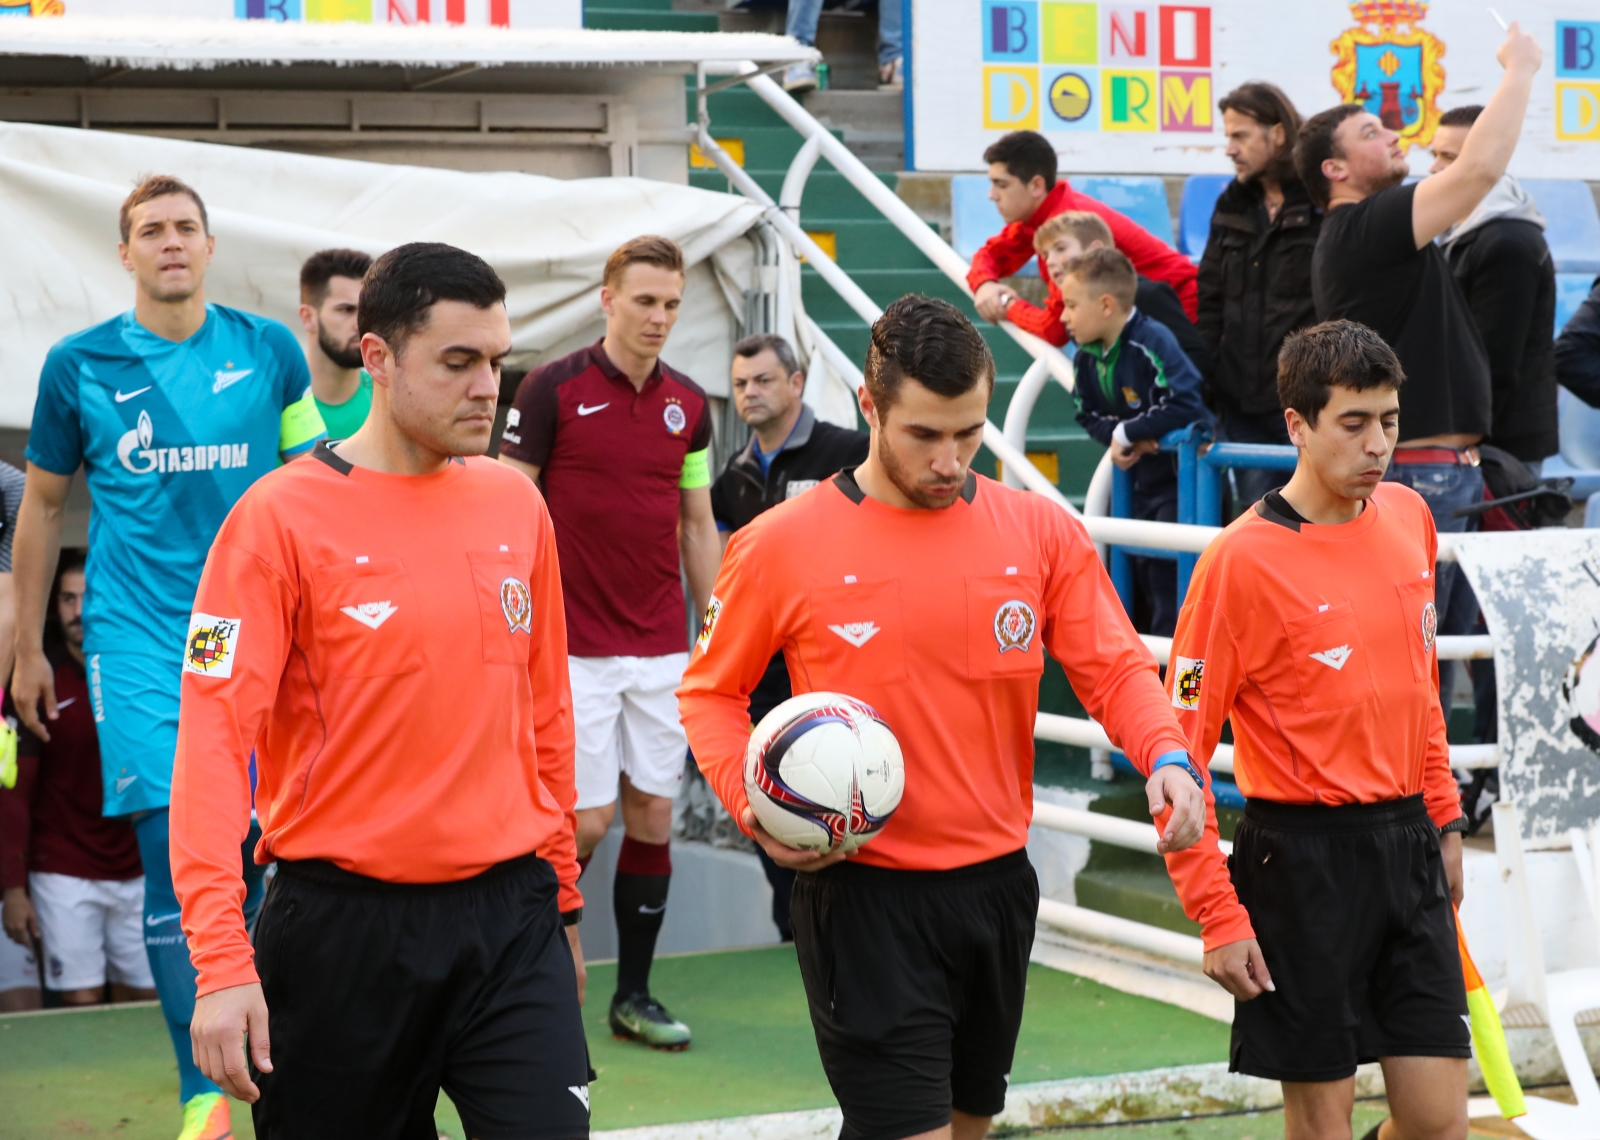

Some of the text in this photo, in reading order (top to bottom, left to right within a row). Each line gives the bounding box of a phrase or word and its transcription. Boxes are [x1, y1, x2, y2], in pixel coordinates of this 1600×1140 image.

[991, 6, 1198, 60] BENI
[990, 72, 1212, 127] DORM
[158, 442, 249, 474] ГАЗПРОМ
